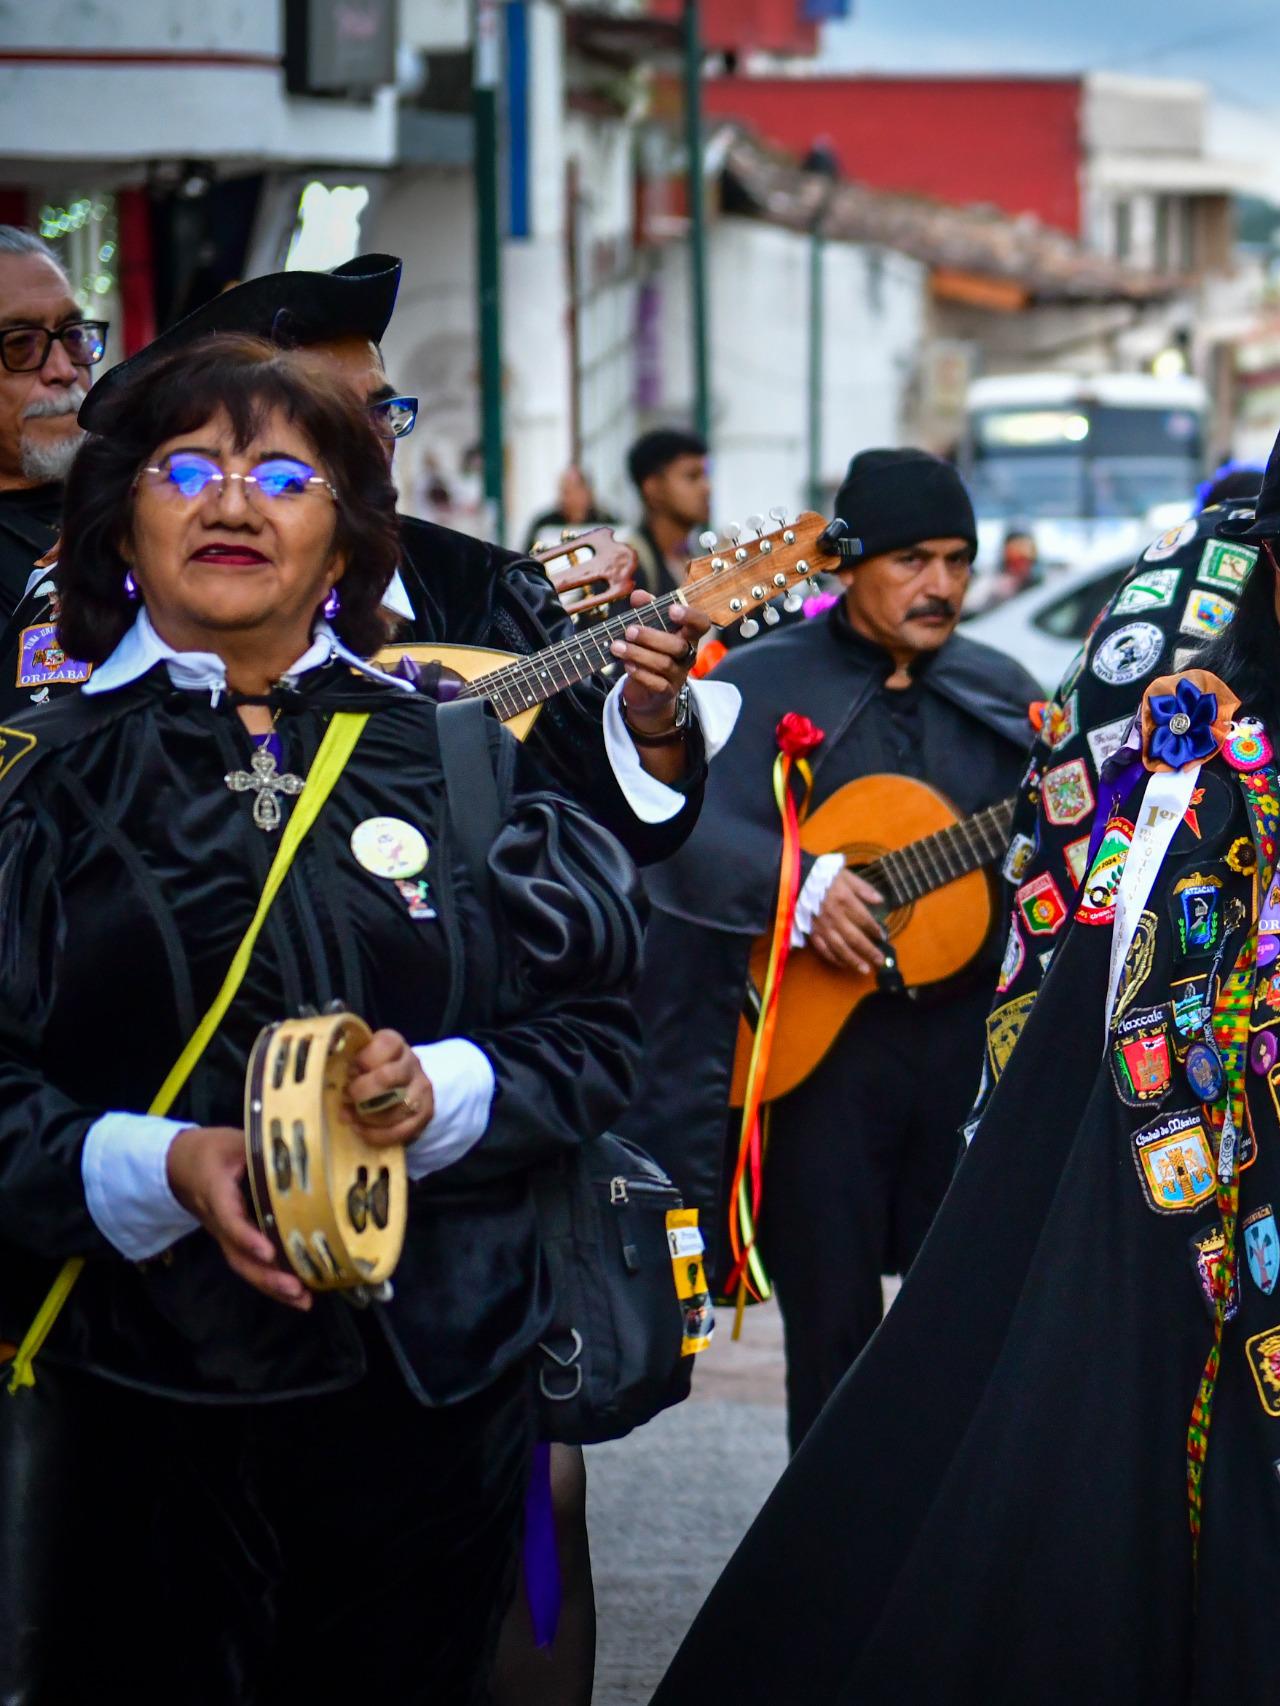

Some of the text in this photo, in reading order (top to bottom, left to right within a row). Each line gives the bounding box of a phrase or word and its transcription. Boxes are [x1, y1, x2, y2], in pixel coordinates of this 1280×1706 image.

[21, 670, 85, 685] ORIZABA
[1143, 805, 1178, 828] 1er
[1101, 857, 1117, 868] 2024
